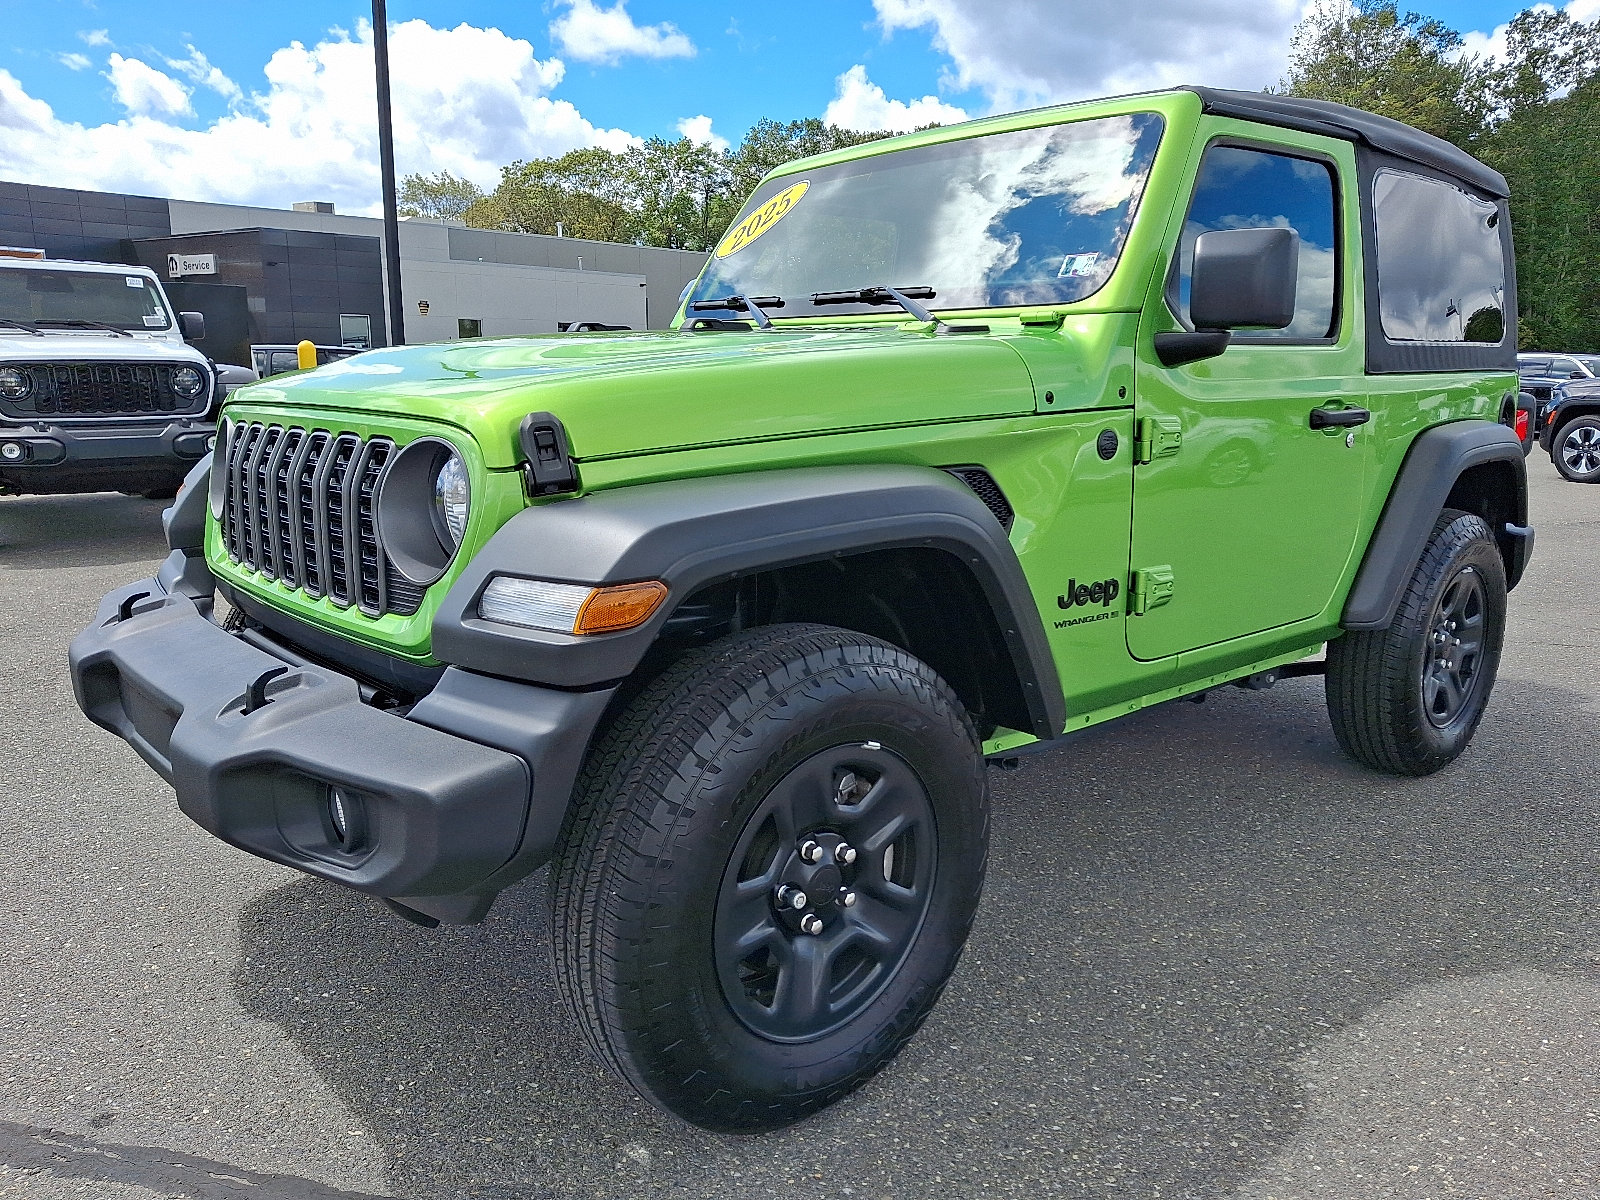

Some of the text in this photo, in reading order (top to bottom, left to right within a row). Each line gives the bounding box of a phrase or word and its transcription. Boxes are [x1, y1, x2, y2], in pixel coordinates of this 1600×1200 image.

[730, 189, 794, 251] 2025
[182, 260, 211, 272] Service
[1057, 577, 1120, 610] Jeep
[1053, 613, 1110, 629] WRANGLER
[795, 995, 929, 1092] NEXN
